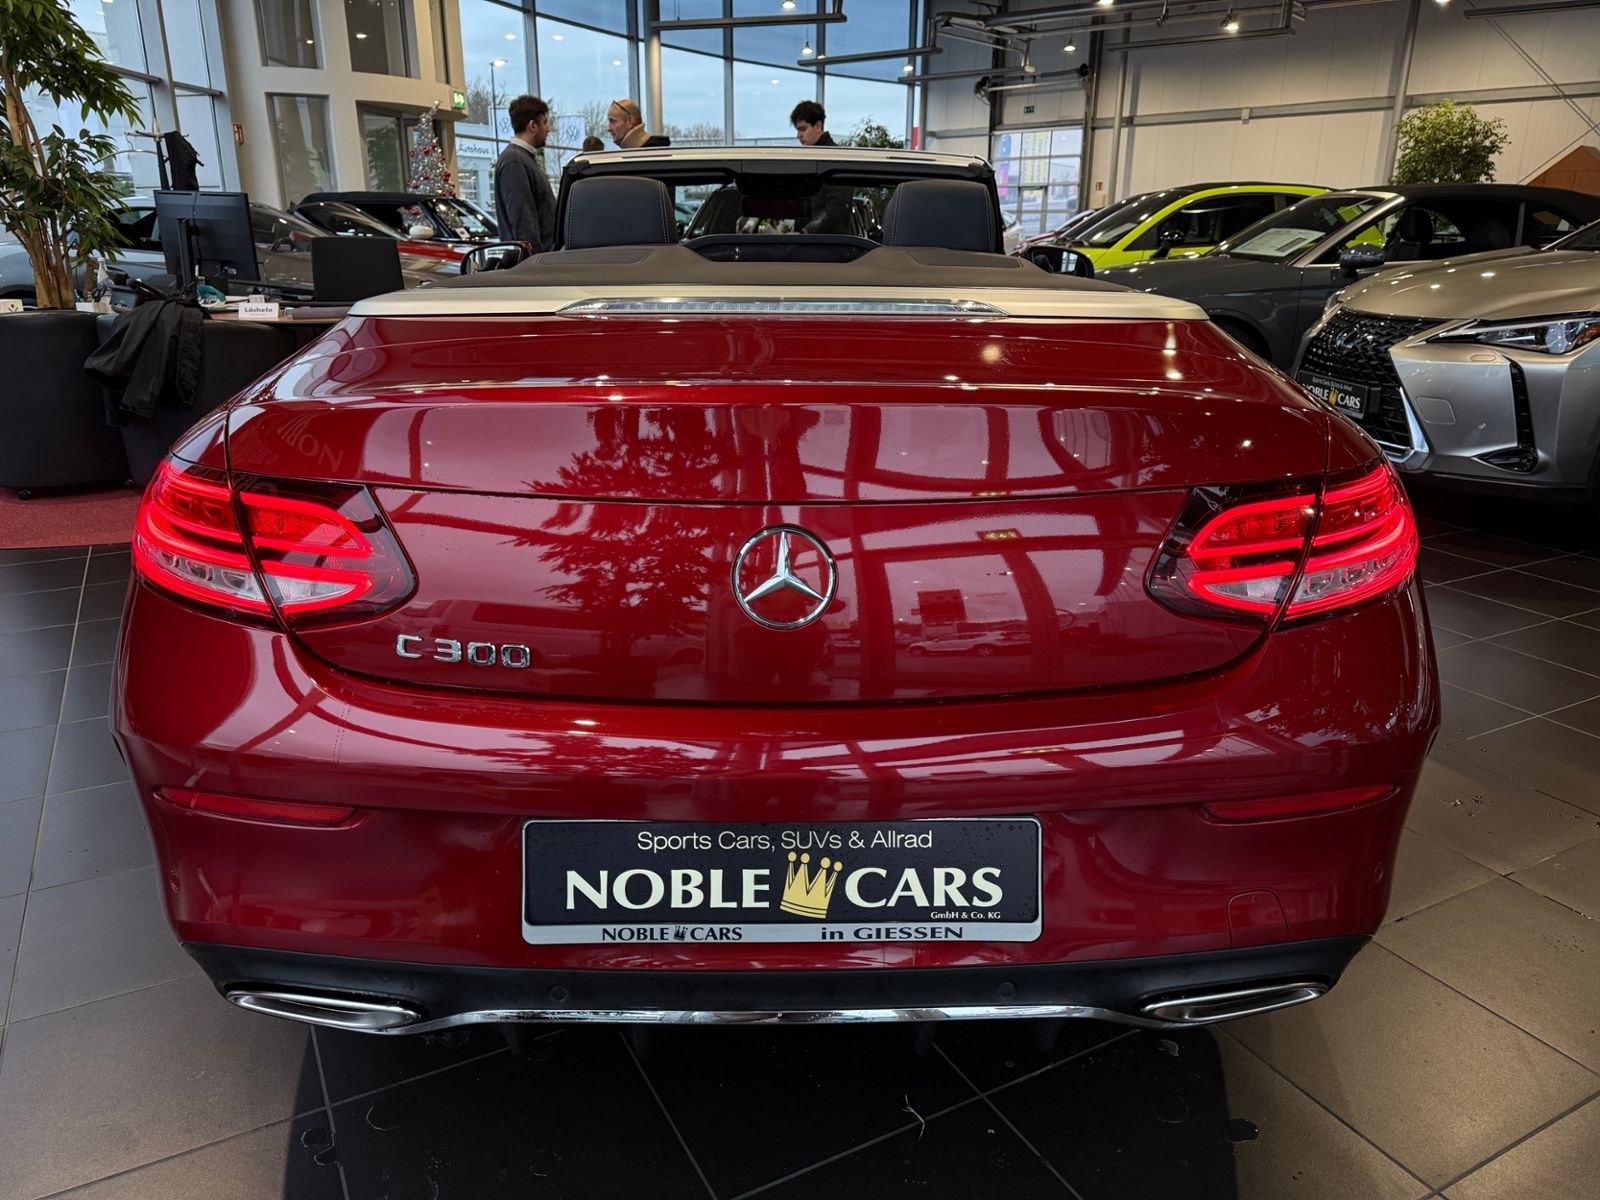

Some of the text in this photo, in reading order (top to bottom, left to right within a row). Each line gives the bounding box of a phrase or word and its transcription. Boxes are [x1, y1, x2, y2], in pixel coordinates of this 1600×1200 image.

[1302, 383, 1330, 401] OBLE
[1337, 392, 1361, 409] CARS
[396, 633, 532, 668] C 300
[637, 830, 933, 854] Sports Cars, SUVs & Allrad
[566, 866, 1003, 910] NOBLE CARS
[930, 911, 1001, 919] GmbH & Co. KG
[602, 926, 963, 942] NOBLE CARS in GIESSEN
